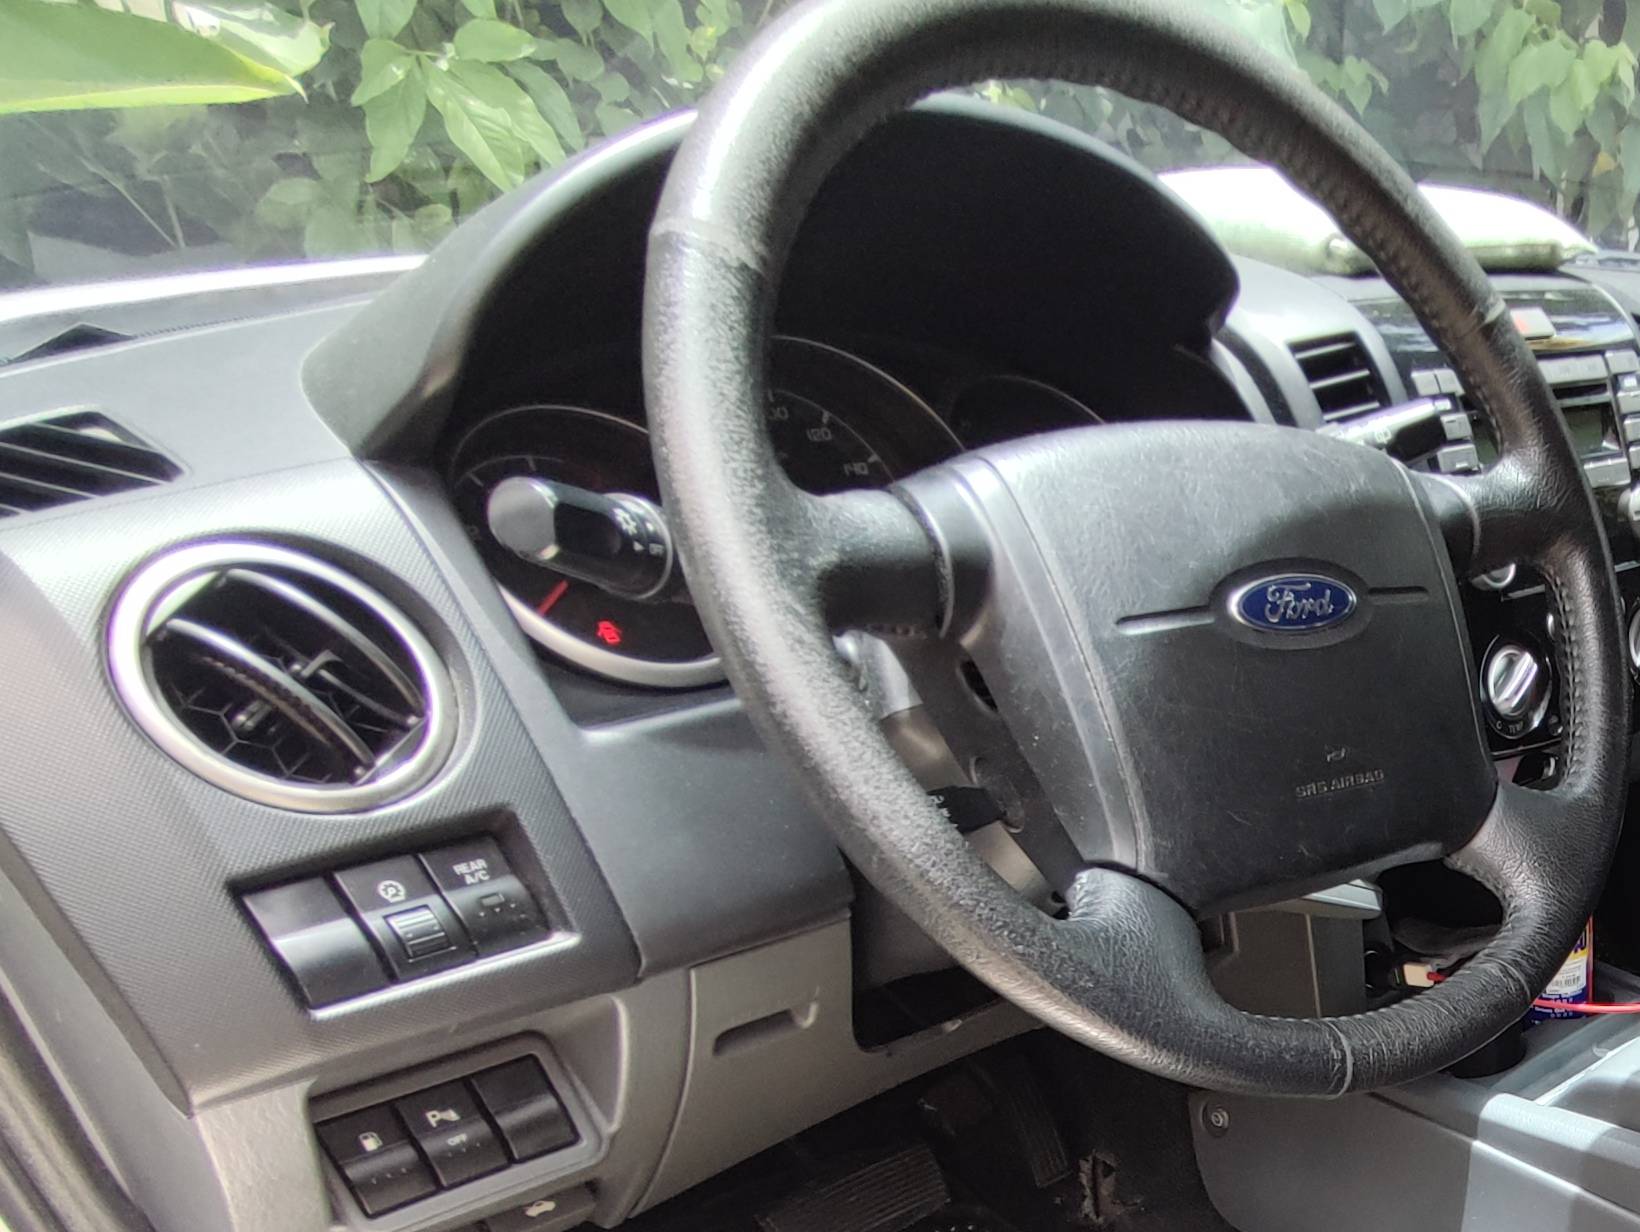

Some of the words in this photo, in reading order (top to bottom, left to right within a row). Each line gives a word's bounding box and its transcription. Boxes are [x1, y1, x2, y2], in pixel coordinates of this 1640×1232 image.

[806, 427, 832, 441] 120
[843, 462, 869, 476] 140
[1264, 581, 1334, 623] Ford
[1295, 780, 1328, 797] SRS
[1330, 768, 1384, 790] AIRBAG
[452, 858, 488, 875] REAR
[464, 870, 490, 885] A/C
[447, 1133, 467, 1146] OFF
